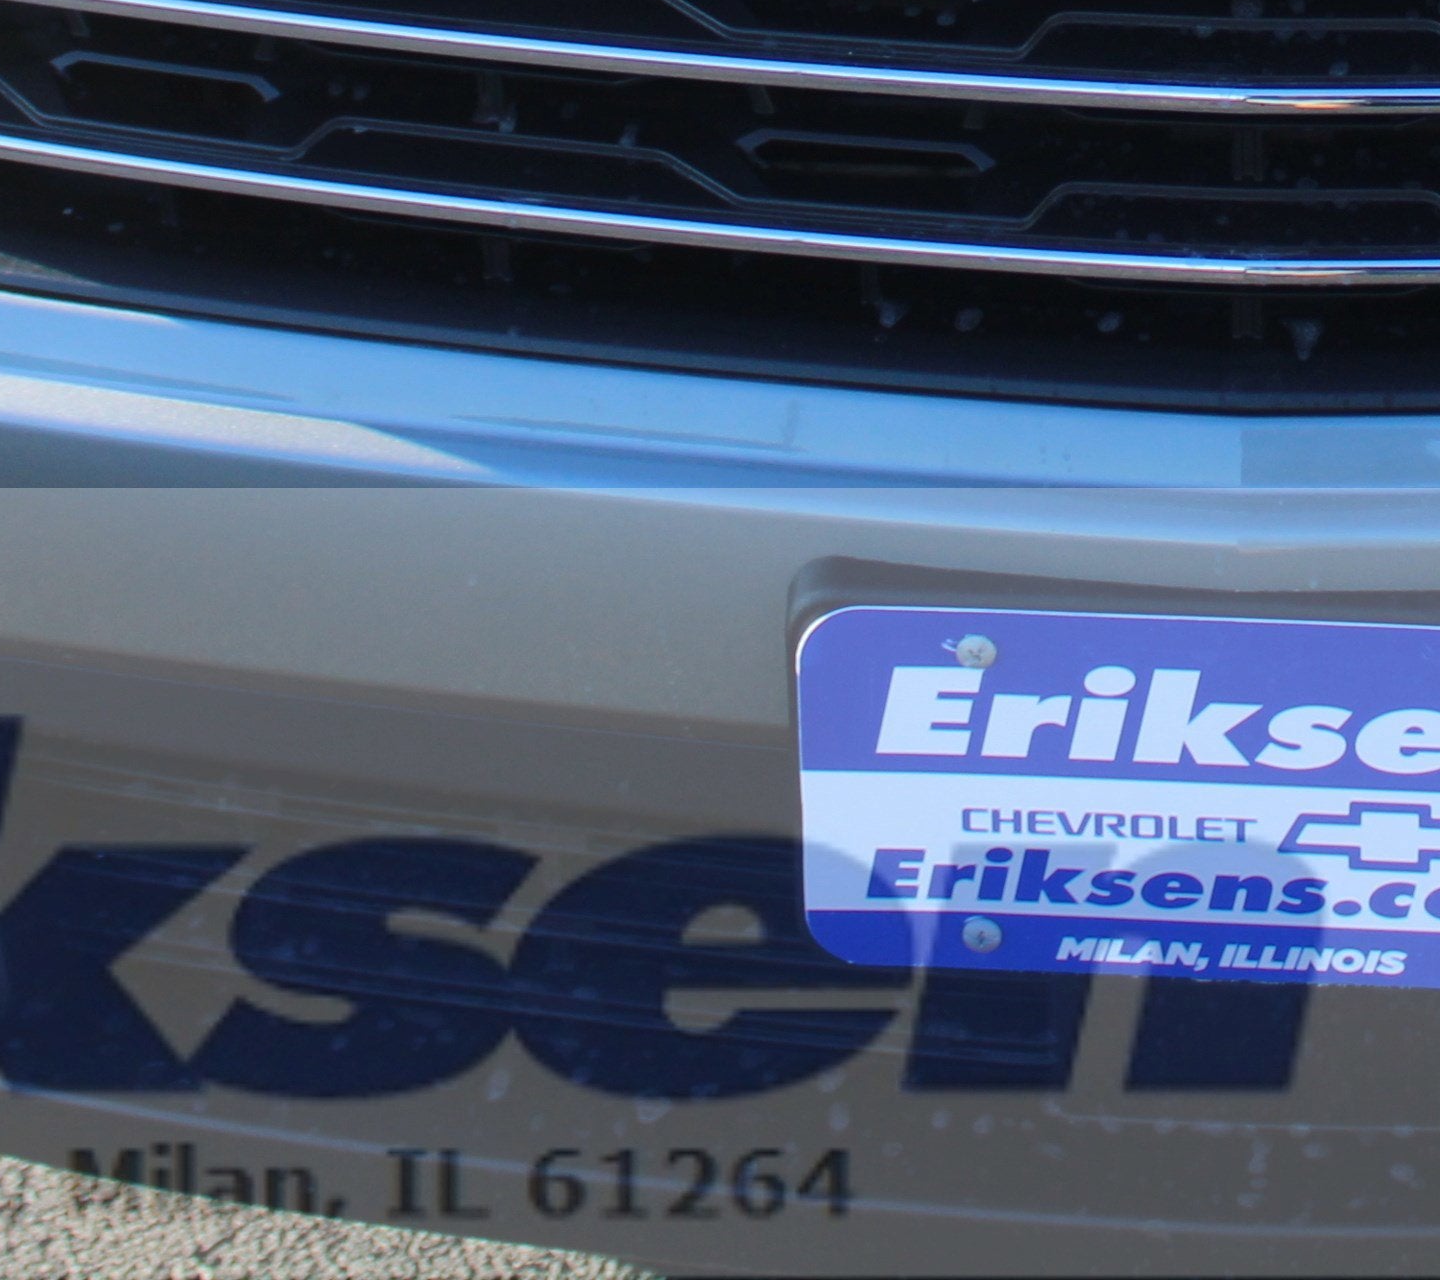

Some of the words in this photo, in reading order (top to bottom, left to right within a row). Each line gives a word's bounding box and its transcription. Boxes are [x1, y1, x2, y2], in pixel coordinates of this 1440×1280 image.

[961, 807, 1257, 844] CHEVROLET
[1056, 936, 1208, 972] MILAN,
[1218, 943, 1407, 976] ILLINOIS
